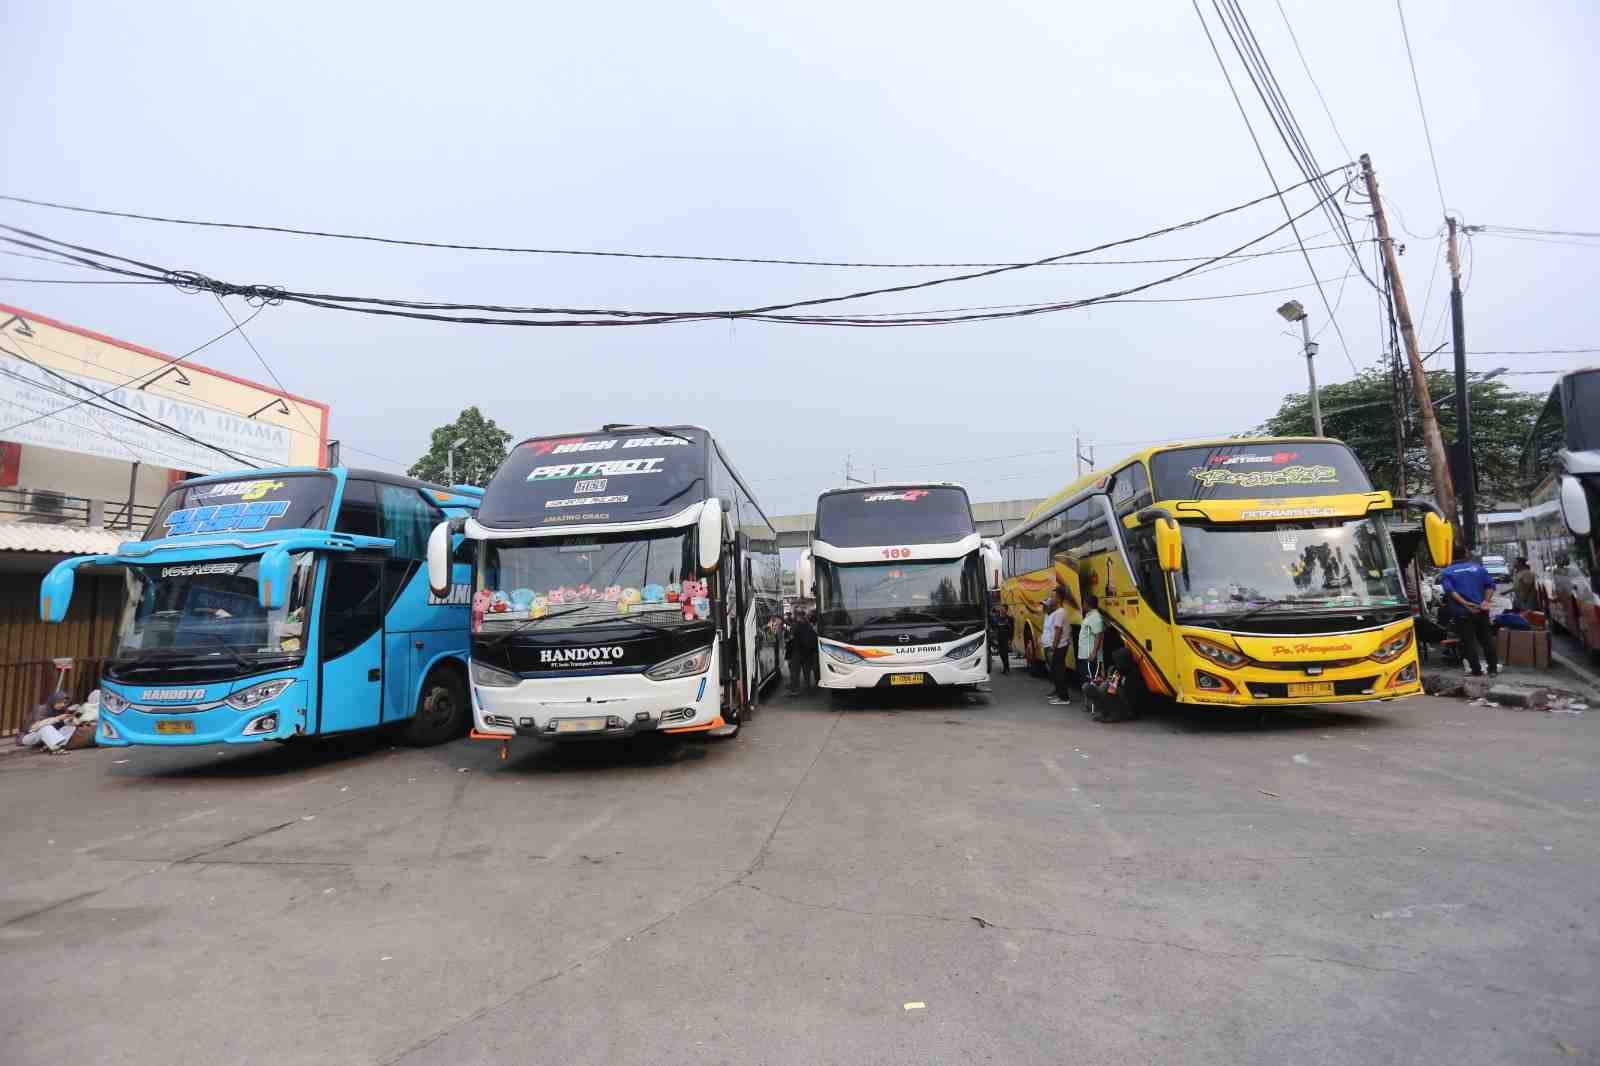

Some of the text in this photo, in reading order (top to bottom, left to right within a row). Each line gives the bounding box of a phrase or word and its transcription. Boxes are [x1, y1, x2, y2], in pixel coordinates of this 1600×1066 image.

[158, 399, 284, 444] JAYA UTAMA
[526, 457, 665, 481] PATRIOT
[540, 646, 624, 663] HANDOYO
[917, 645, 942, 653] PRIMA
[144, 688, 206, 700] HANDOYO
